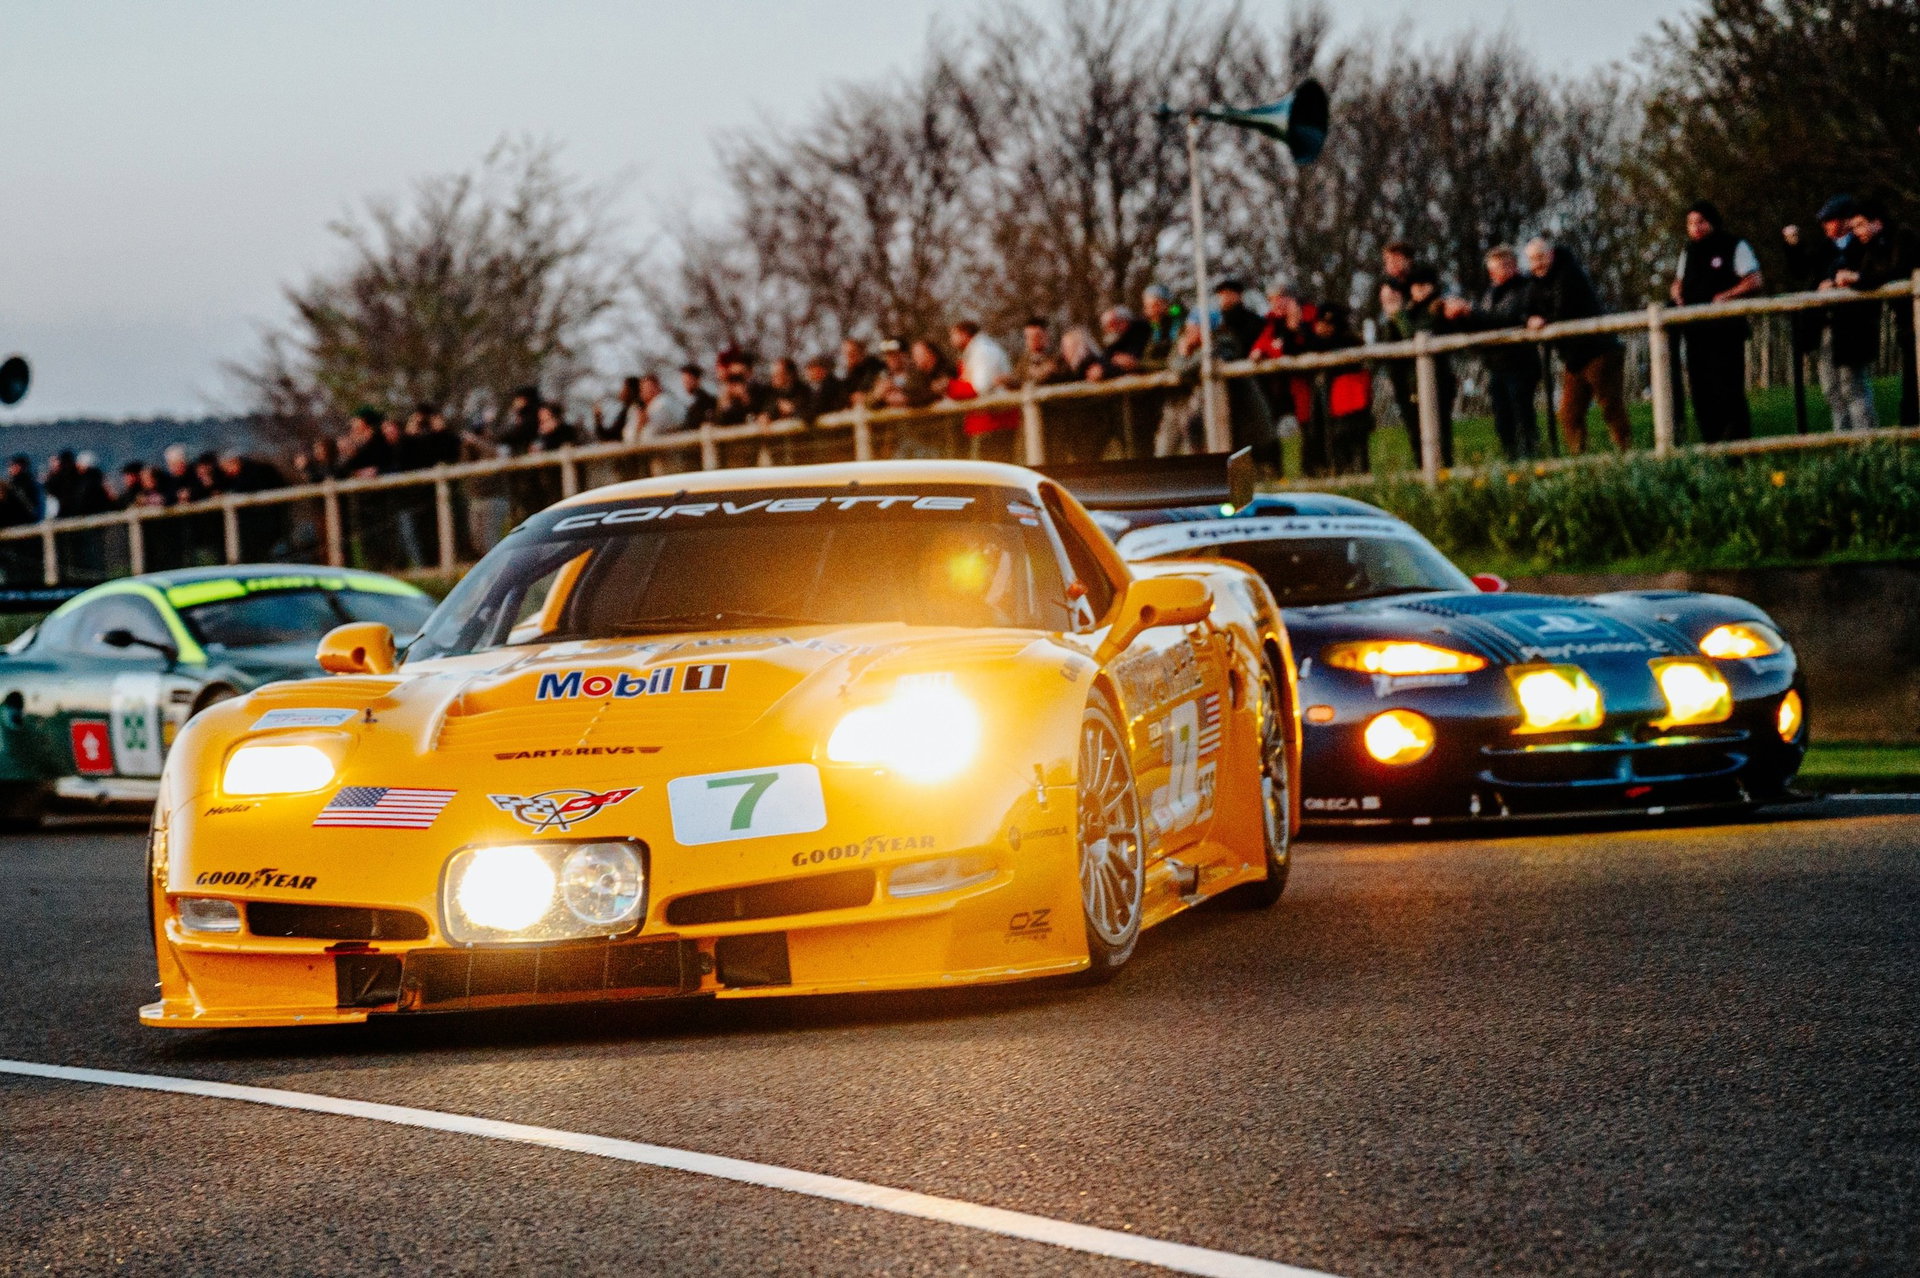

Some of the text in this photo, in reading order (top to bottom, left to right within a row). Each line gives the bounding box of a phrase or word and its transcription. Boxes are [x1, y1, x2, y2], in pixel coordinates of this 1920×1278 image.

[552, 496, 975, 532] CORVETTE
[537, 667, 674, 699] Mobil
[515, 746, 635, 759] ART&REVS
[706, 772, 779, 831] 7
[1009, 908, 1052, 931] OZ
